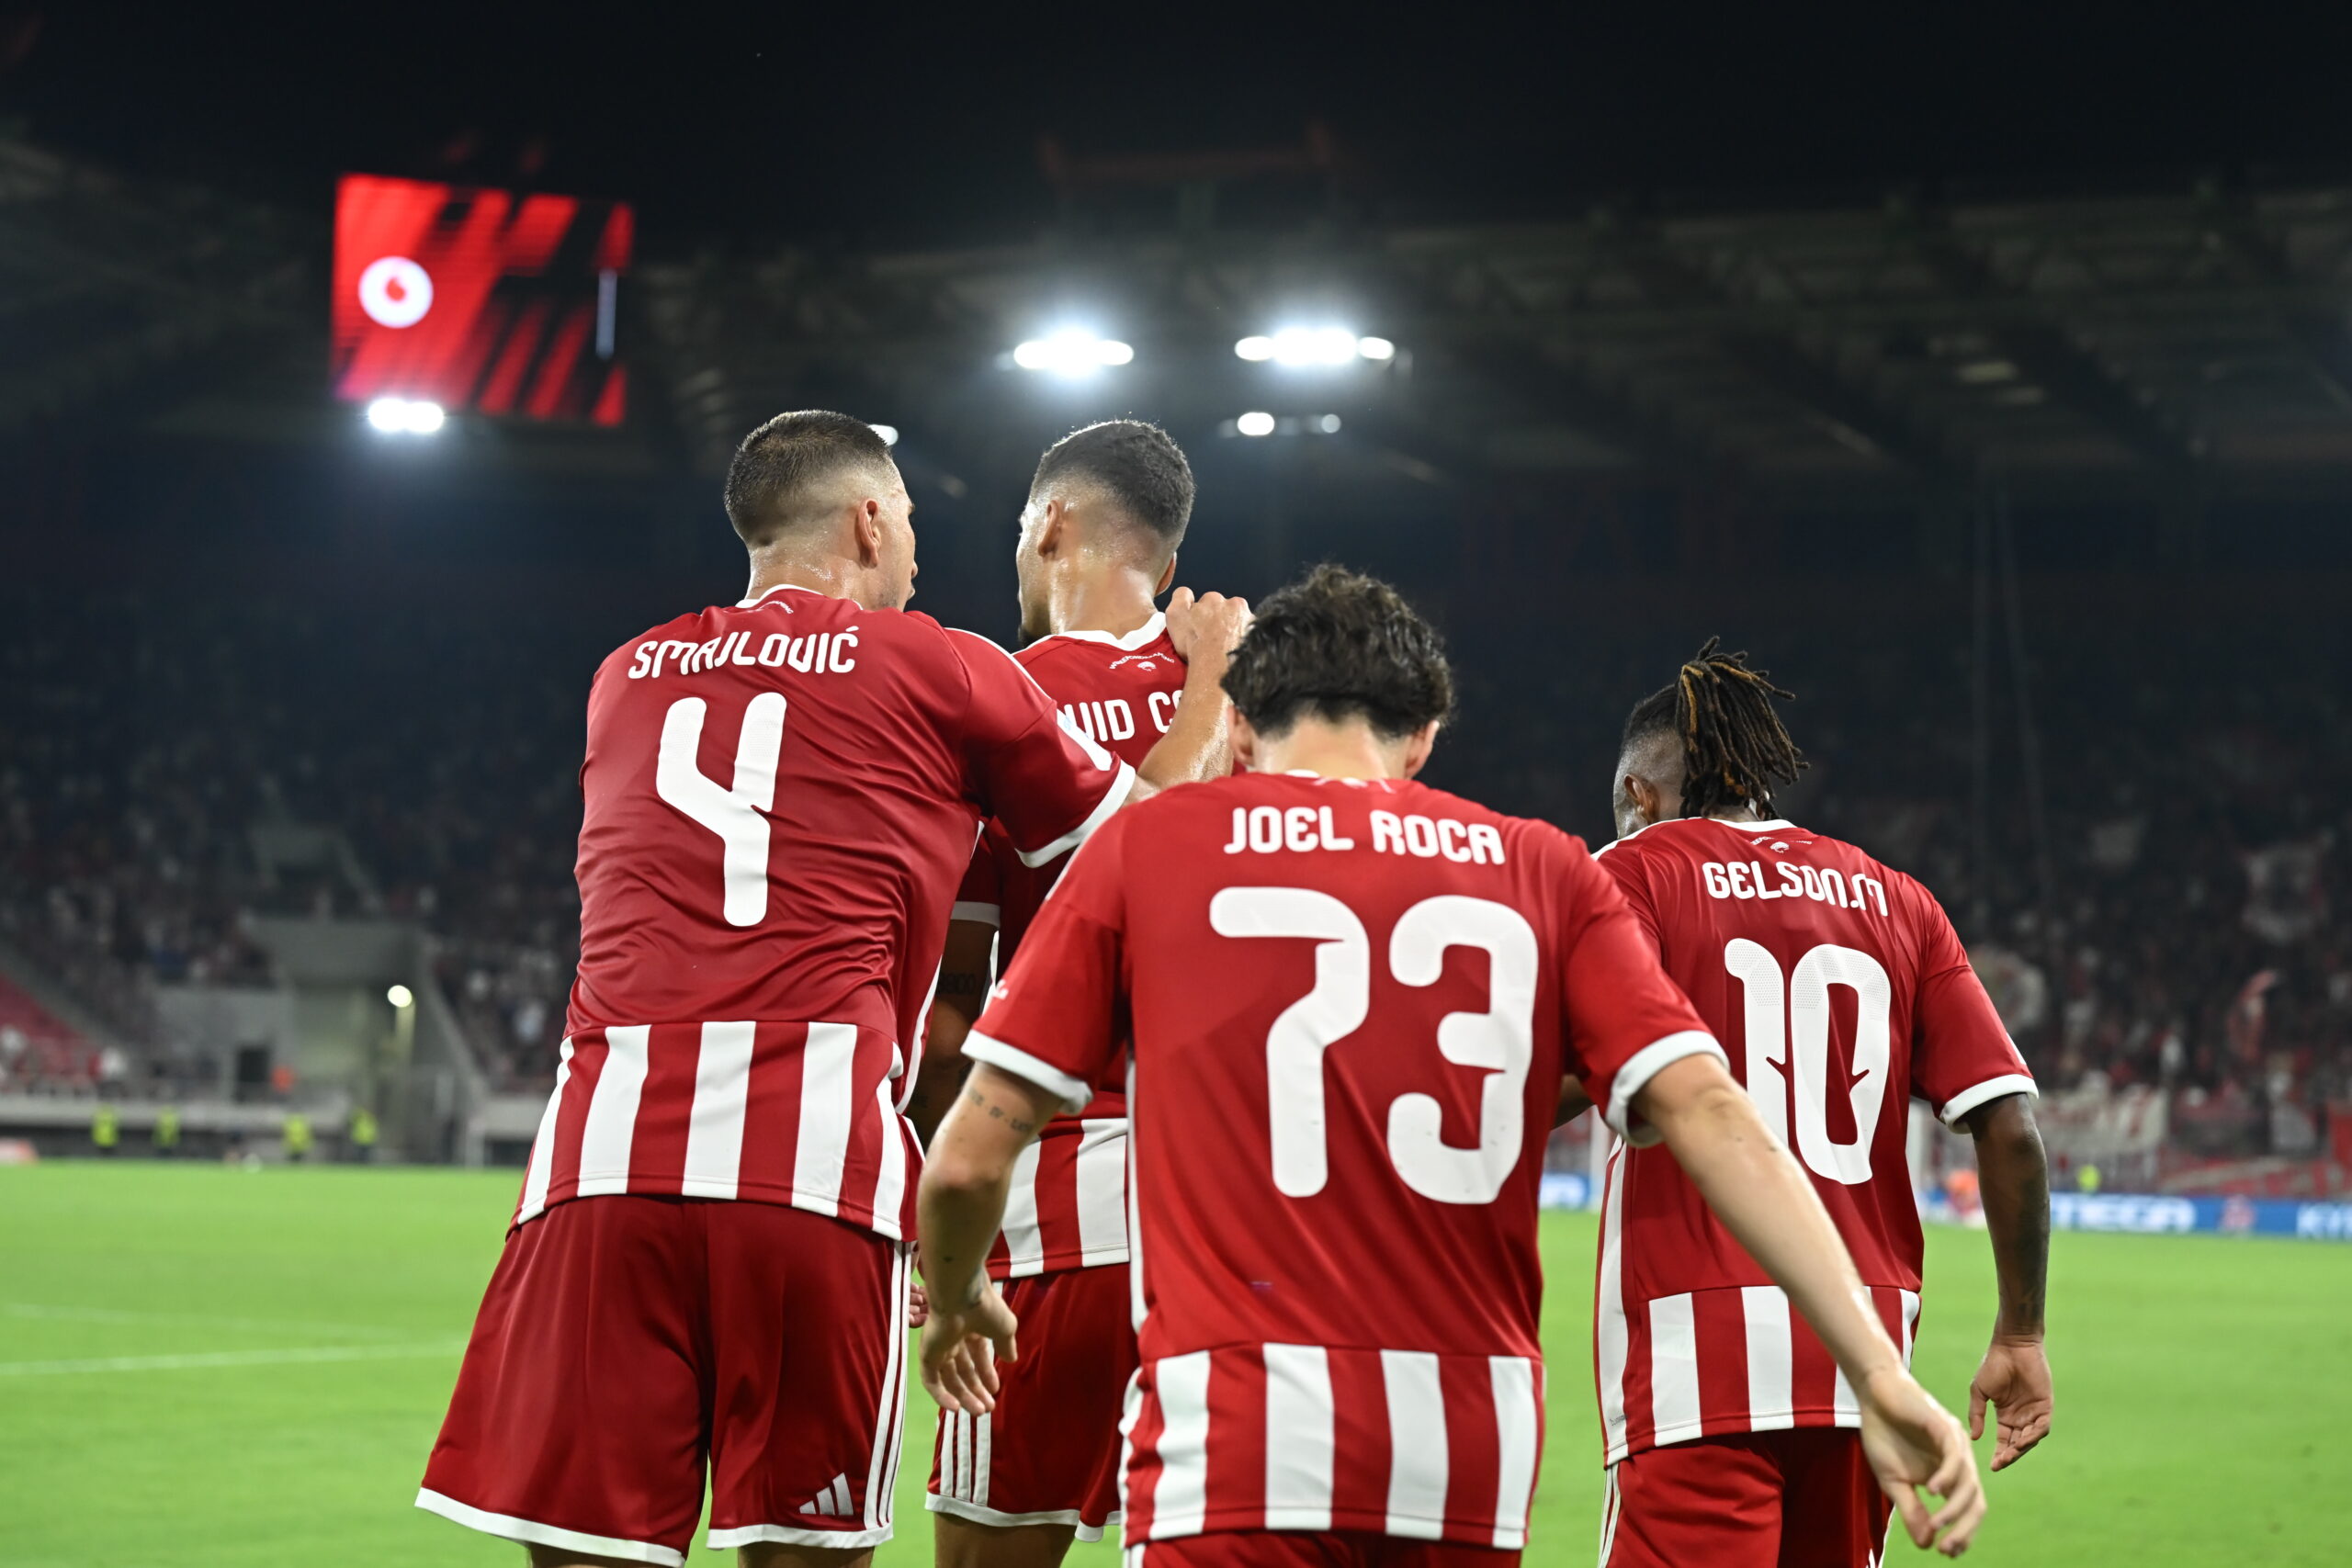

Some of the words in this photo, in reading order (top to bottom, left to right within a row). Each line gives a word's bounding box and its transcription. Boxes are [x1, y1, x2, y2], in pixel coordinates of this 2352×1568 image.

[628, 626, 860, 680] SMAJLOVIĆ
[1063, 698, 1136, 742] VID
[655, 691, 788, 928] 4
[1223, 806, 1355, 854] JOEL
[1369, 809, 1506, 865] ROCA
[1702, 860, 1889, 917] GELSON.M
[1209, 886, 1539, 1205] 73
[1724, 937, 1892, 1186] 10
